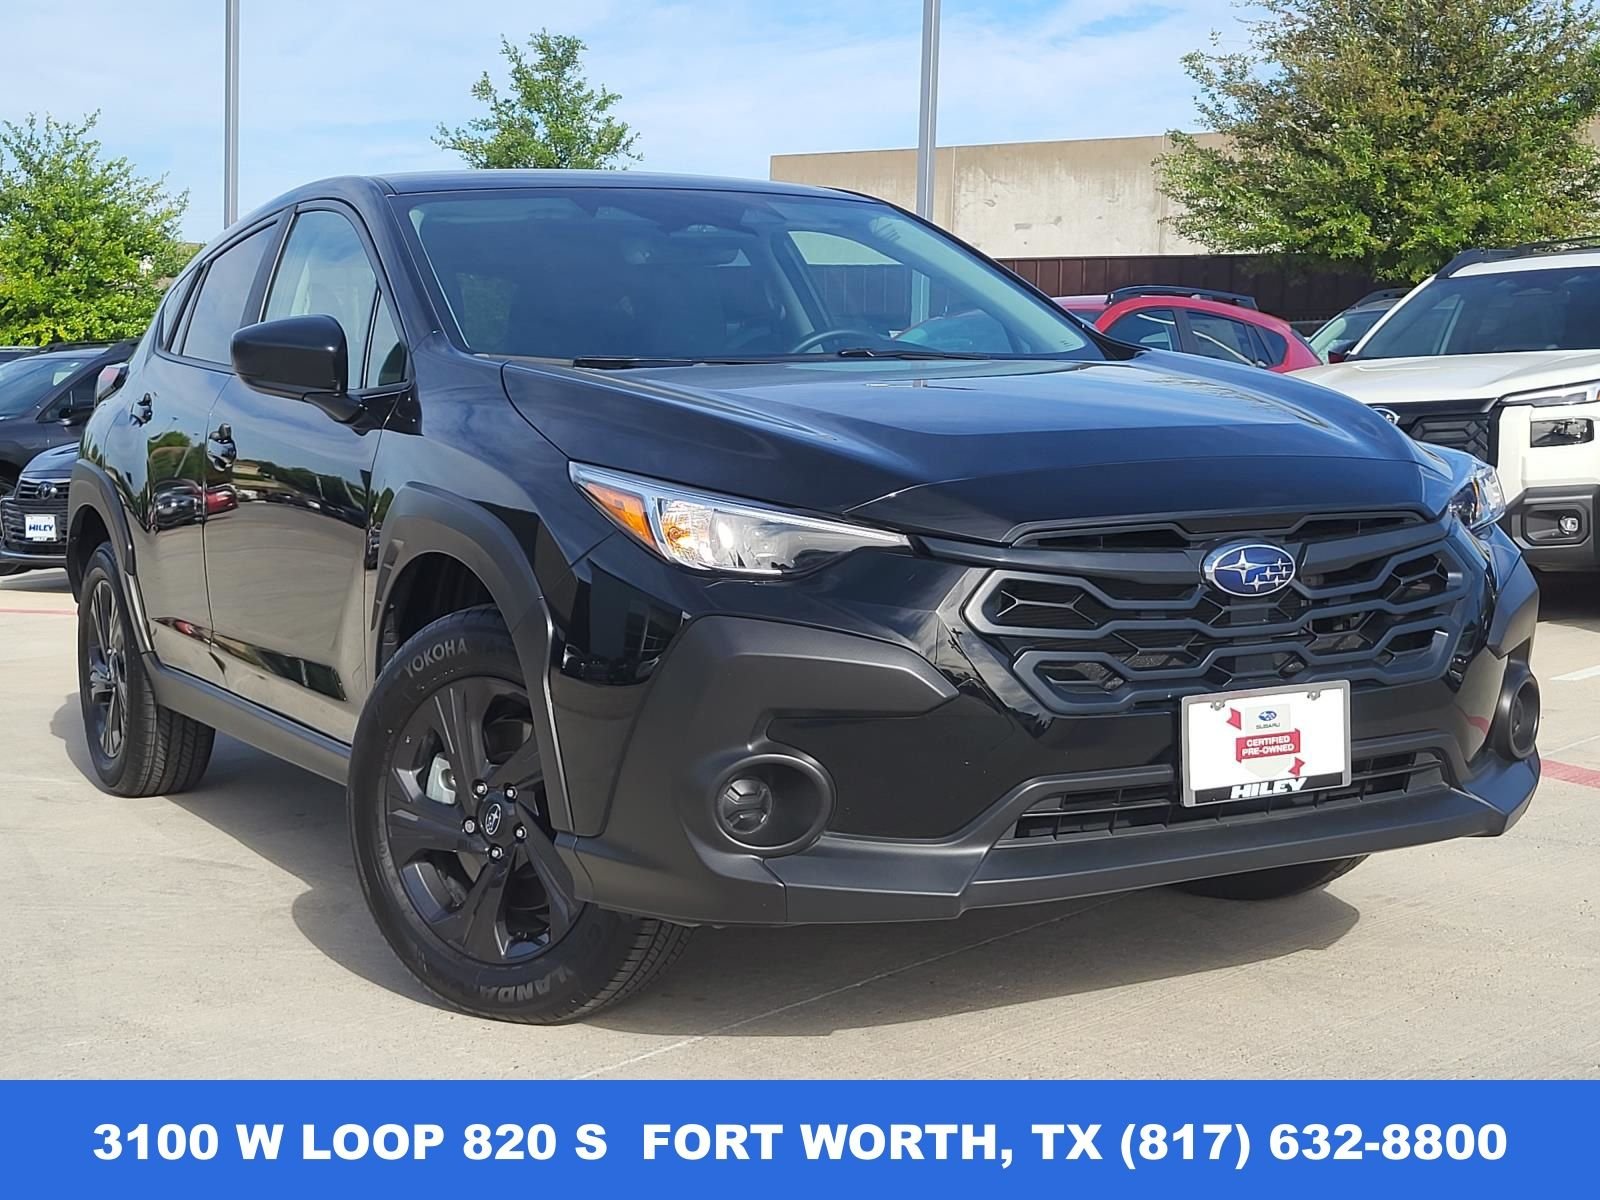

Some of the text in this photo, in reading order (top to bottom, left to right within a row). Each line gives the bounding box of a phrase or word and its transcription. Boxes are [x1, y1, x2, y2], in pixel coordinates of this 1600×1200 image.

[28, 524, 54, 532] HILEY
[1255, 722, 1281, 730] SUBARU
[1246, 735, 1291, 748] CERTIFIED
[1241, 743, 1296, 757] PRE-OWNED
[1230, 777, 1307, 800] HILEY
